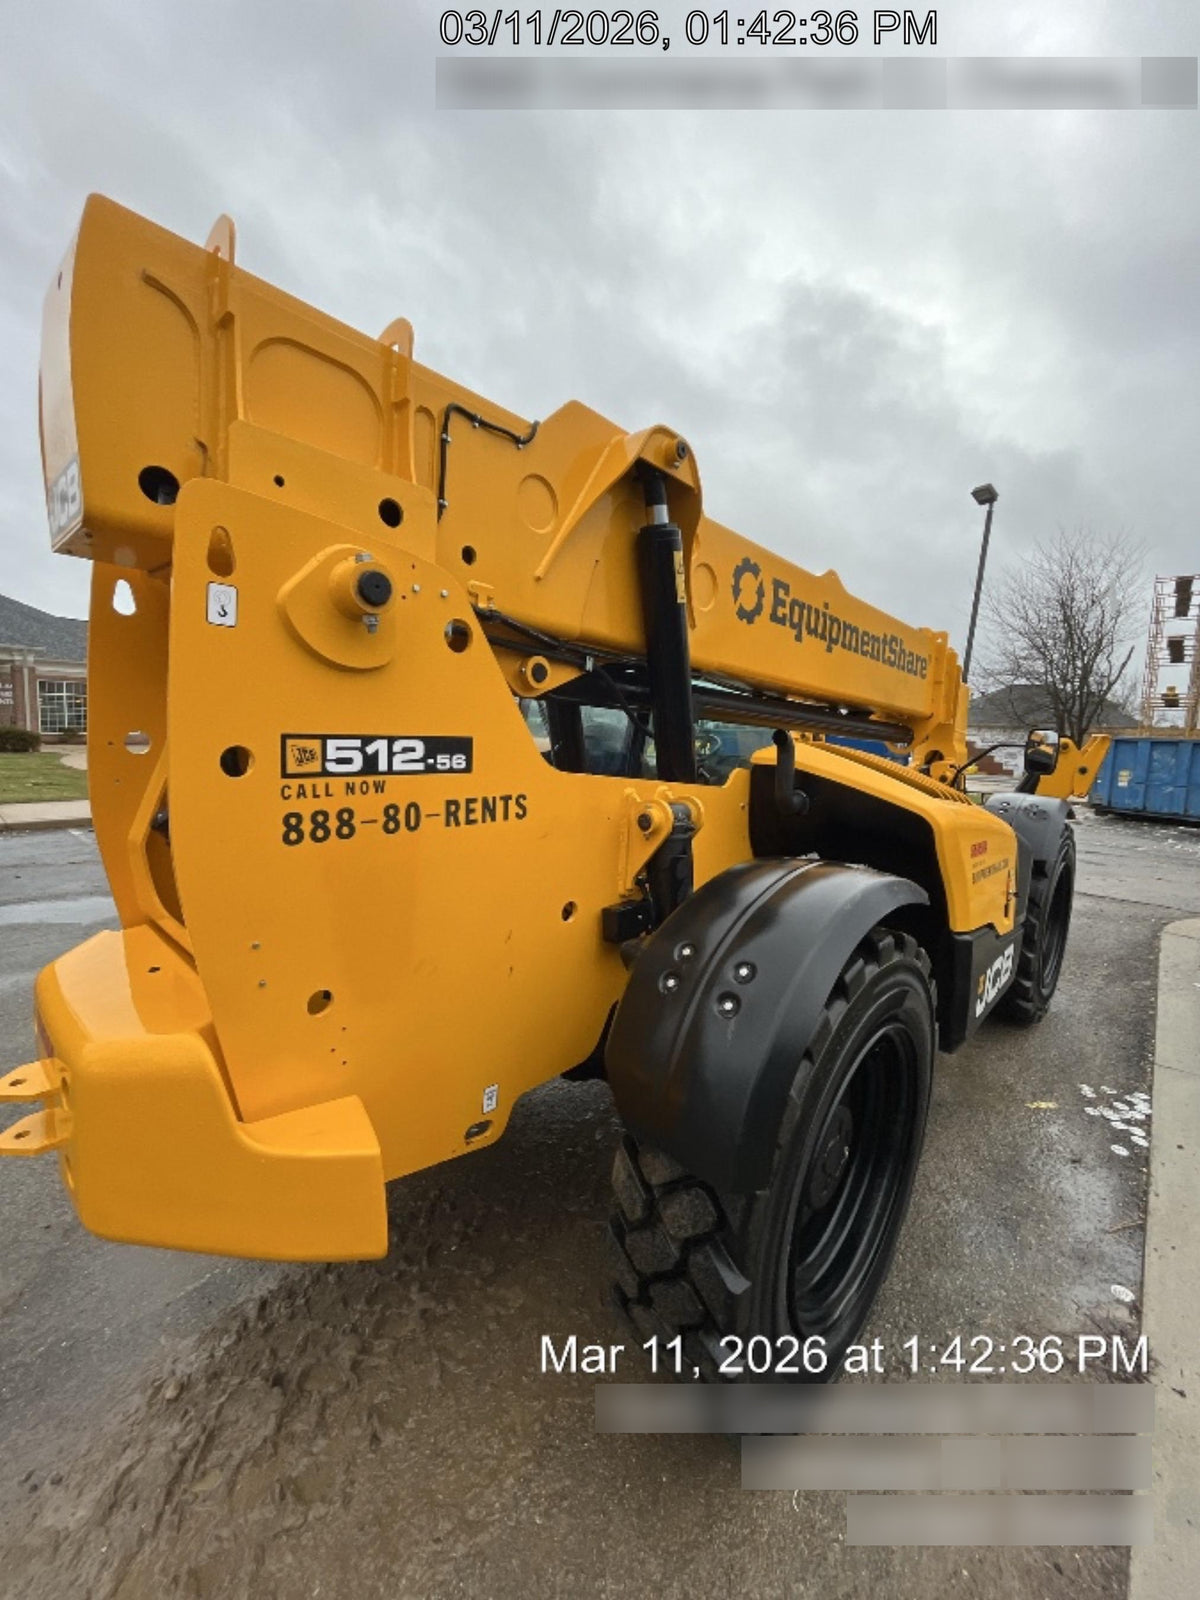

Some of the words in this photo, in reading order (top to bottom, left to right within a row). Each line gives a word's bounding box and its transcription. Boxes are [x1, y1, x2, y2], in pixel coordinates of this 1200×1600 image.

[769, 577, 928, 680] EquipmentShare
[325, 738, 467, 773] 512-56
[280, 783, 334, 800] CALL
[345, 780, 387, 796] NOW
[281, 794, 528, 847] 888-80-RENTS
[975, 943, 1015, 1018] JCB
